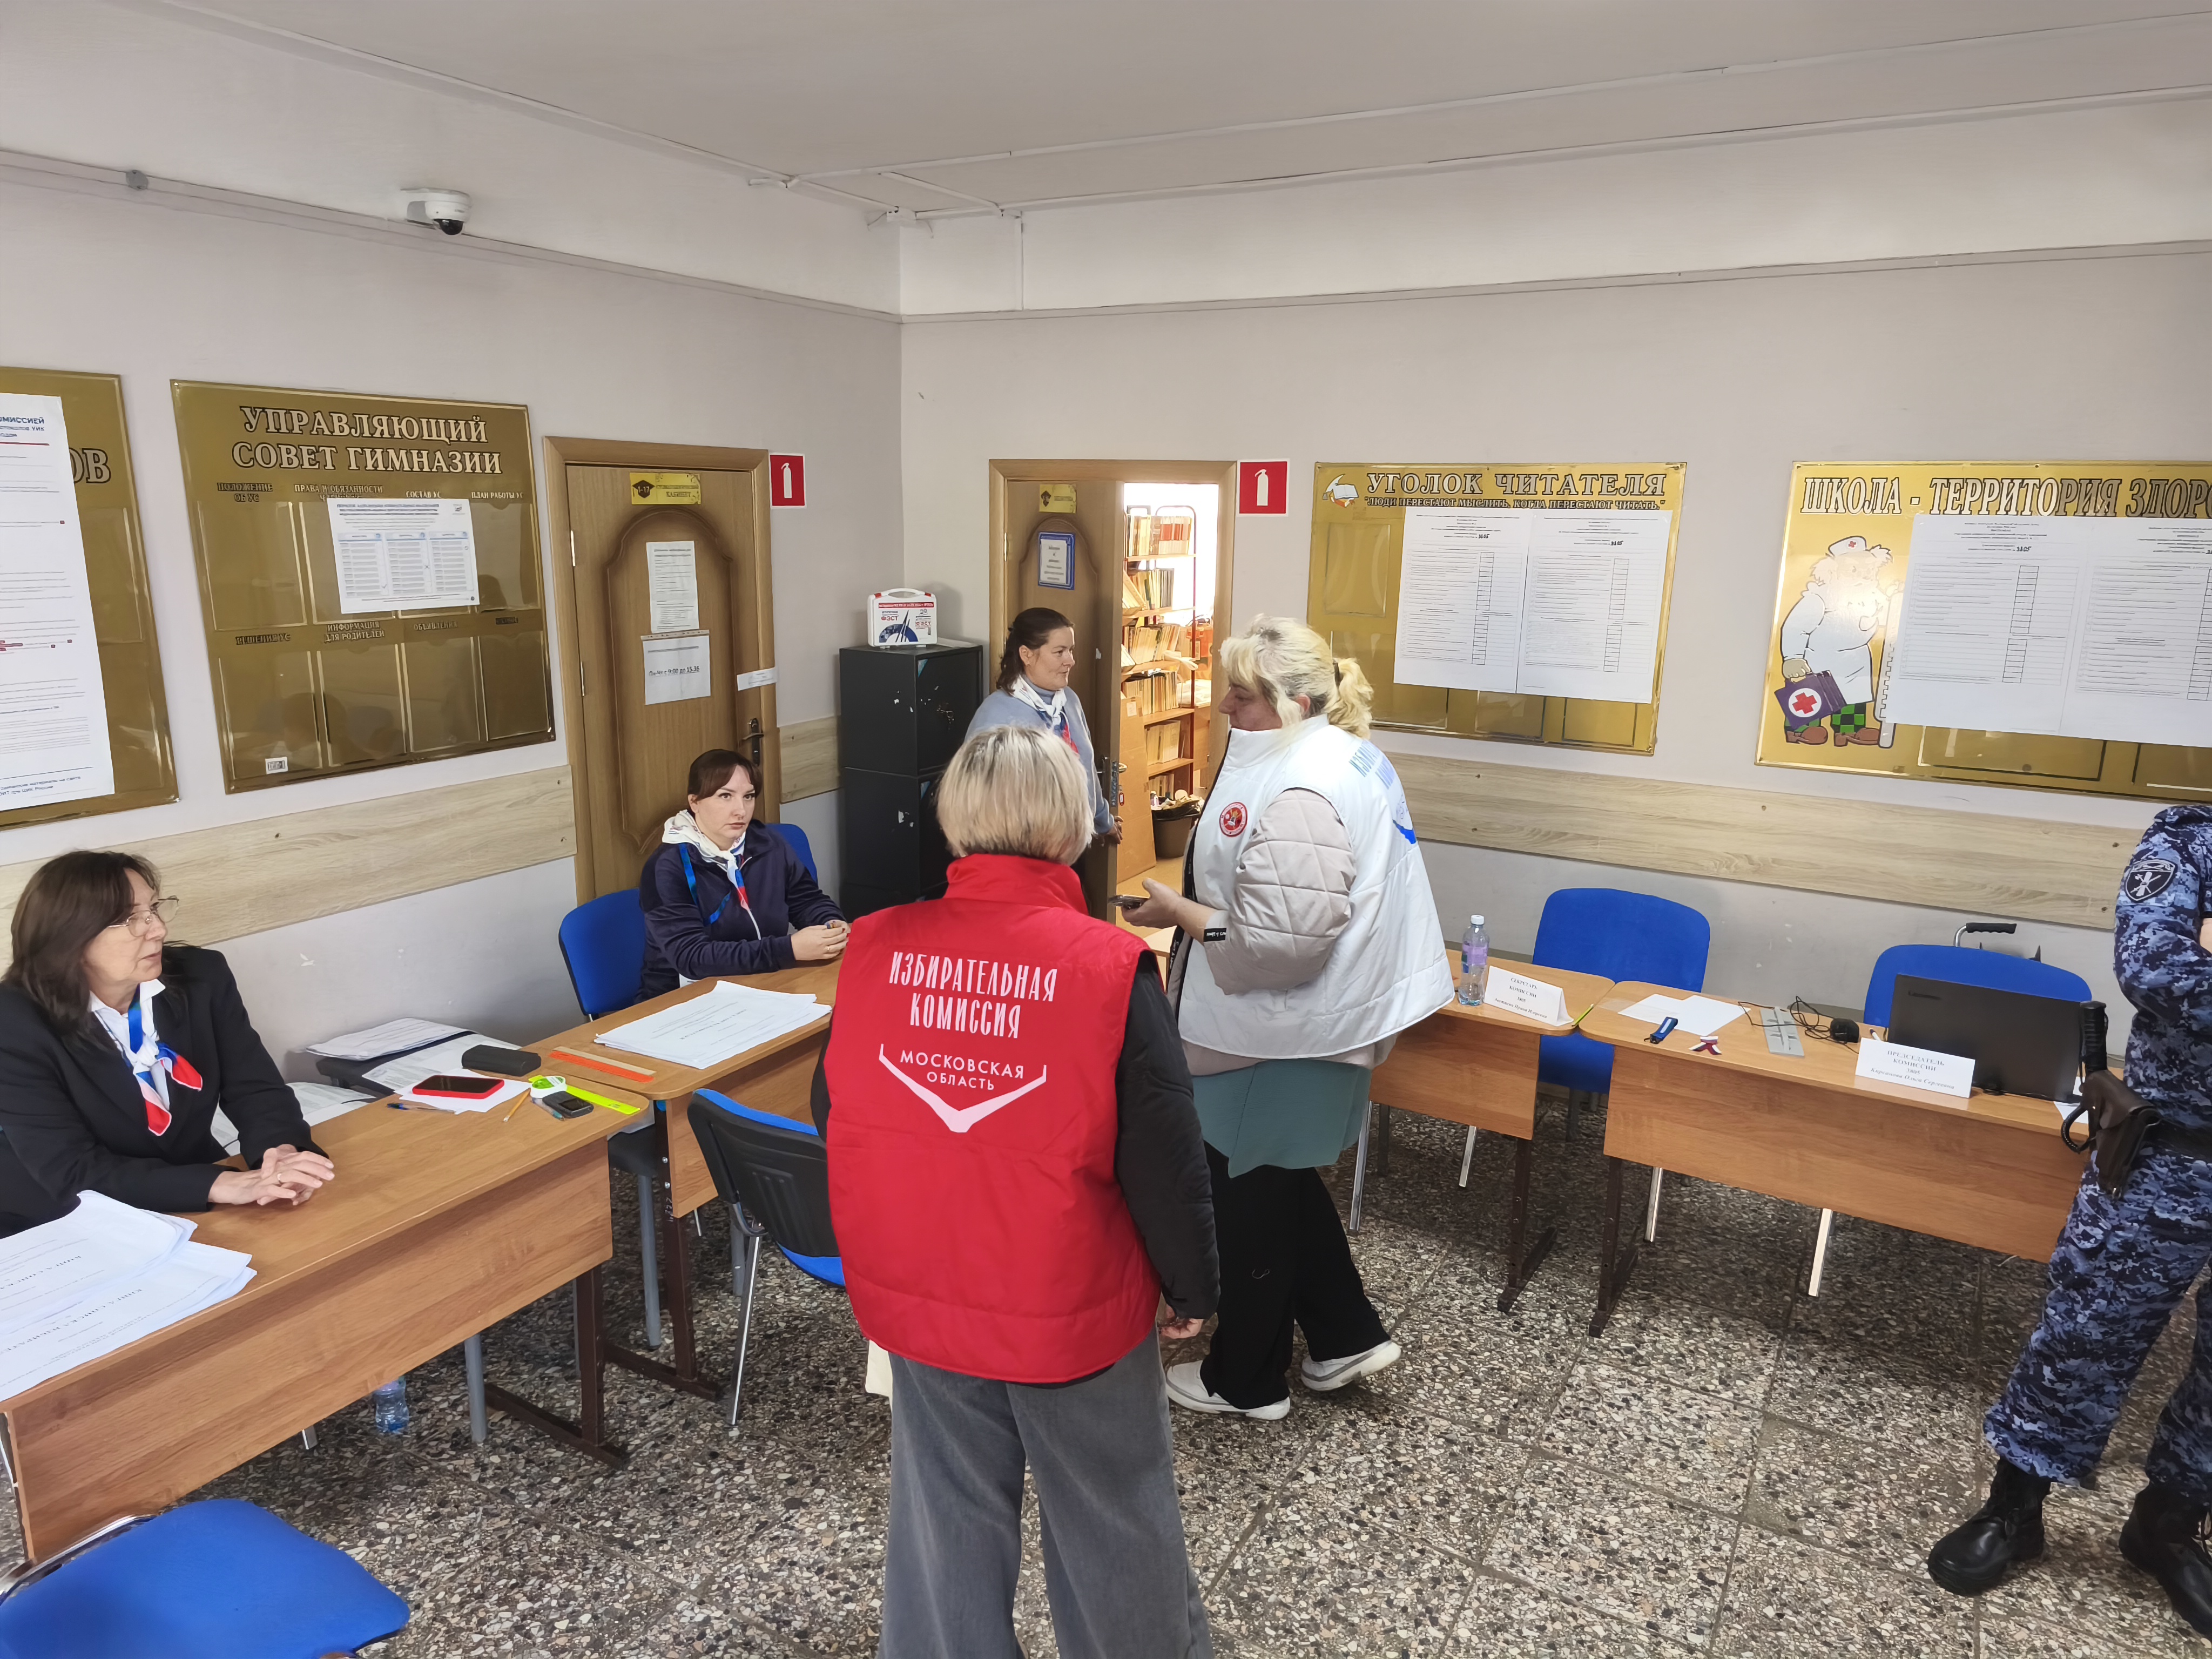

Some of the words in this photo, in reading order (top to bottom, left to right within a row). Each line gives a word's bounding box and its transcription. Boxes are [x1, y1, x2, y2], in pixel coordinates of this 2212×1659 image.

[239, 406, 489, 445] УПРАВЛЯЮЩИЙ
[232, 441, 338, 470] СОВЕТ
[347, 447, 503, 474] ГИМНАЗИИ
[217, 483, 273, 492] ПОЛОЖЕНИЕ
[294, 484, 320, 493] ПРАВА
[322, 484, 328, 493] И
[329, 484, 383, 494] ОБЯЗАННОСТИ
[1366, 473, 1483, 495] УГОЛОК
[1495, 474, 1667, 496] ЧИТАТЕЛЯ
[234, 494, 246, 502] ОБ
[247, 494, 260, 503] УС
[1399, 498, 1456, 507] ПЕРЕСТАЮТ
[1513, 500, 1546, 509] КОГДА
[1549, 500, 1613, 509] ПЕРЕСТАЮТ
[1800, 477, 1902, 514] ШКОЛА
[1910, 496, 1920, 505] -
[1929, 477, 2122, 517] ТЕРРИТОРИЯ
[2125, 478, 2212, 518] ЗДОР
[327, 621, 380, 632] ИНФОРМАЦИЯ
[413, 621, 458, 631] ОБЪЯВЛЕНИЯ
[235, 634, 279, 645] РЕШЕНИЯ
[325, 633, 339, 643] ДЛЯ
[342, 630, 385, 641] РОДИТЕЛЕЙ
[889, 951, 1057, 1002] ИЗБИРАТЕЛЬНАЯ
[1510, 977, 1537, 990] СЕКРЕТАРЬ
[1509, 986, 1536, 998] КОМИССИИ
[910, 993, 1021, 1038] КОМИССИЯ
[900, 1049, 1023, 1079] МОСКОВСКАЯ
[1887, 1050, 1945, 1066] ПРЕДСЕДАТЕЛЬ
[1893, 1058, 1936, 1071] КОМИССИИ
[927, 1071, 994, 1090] ОБЛАСТЬ
